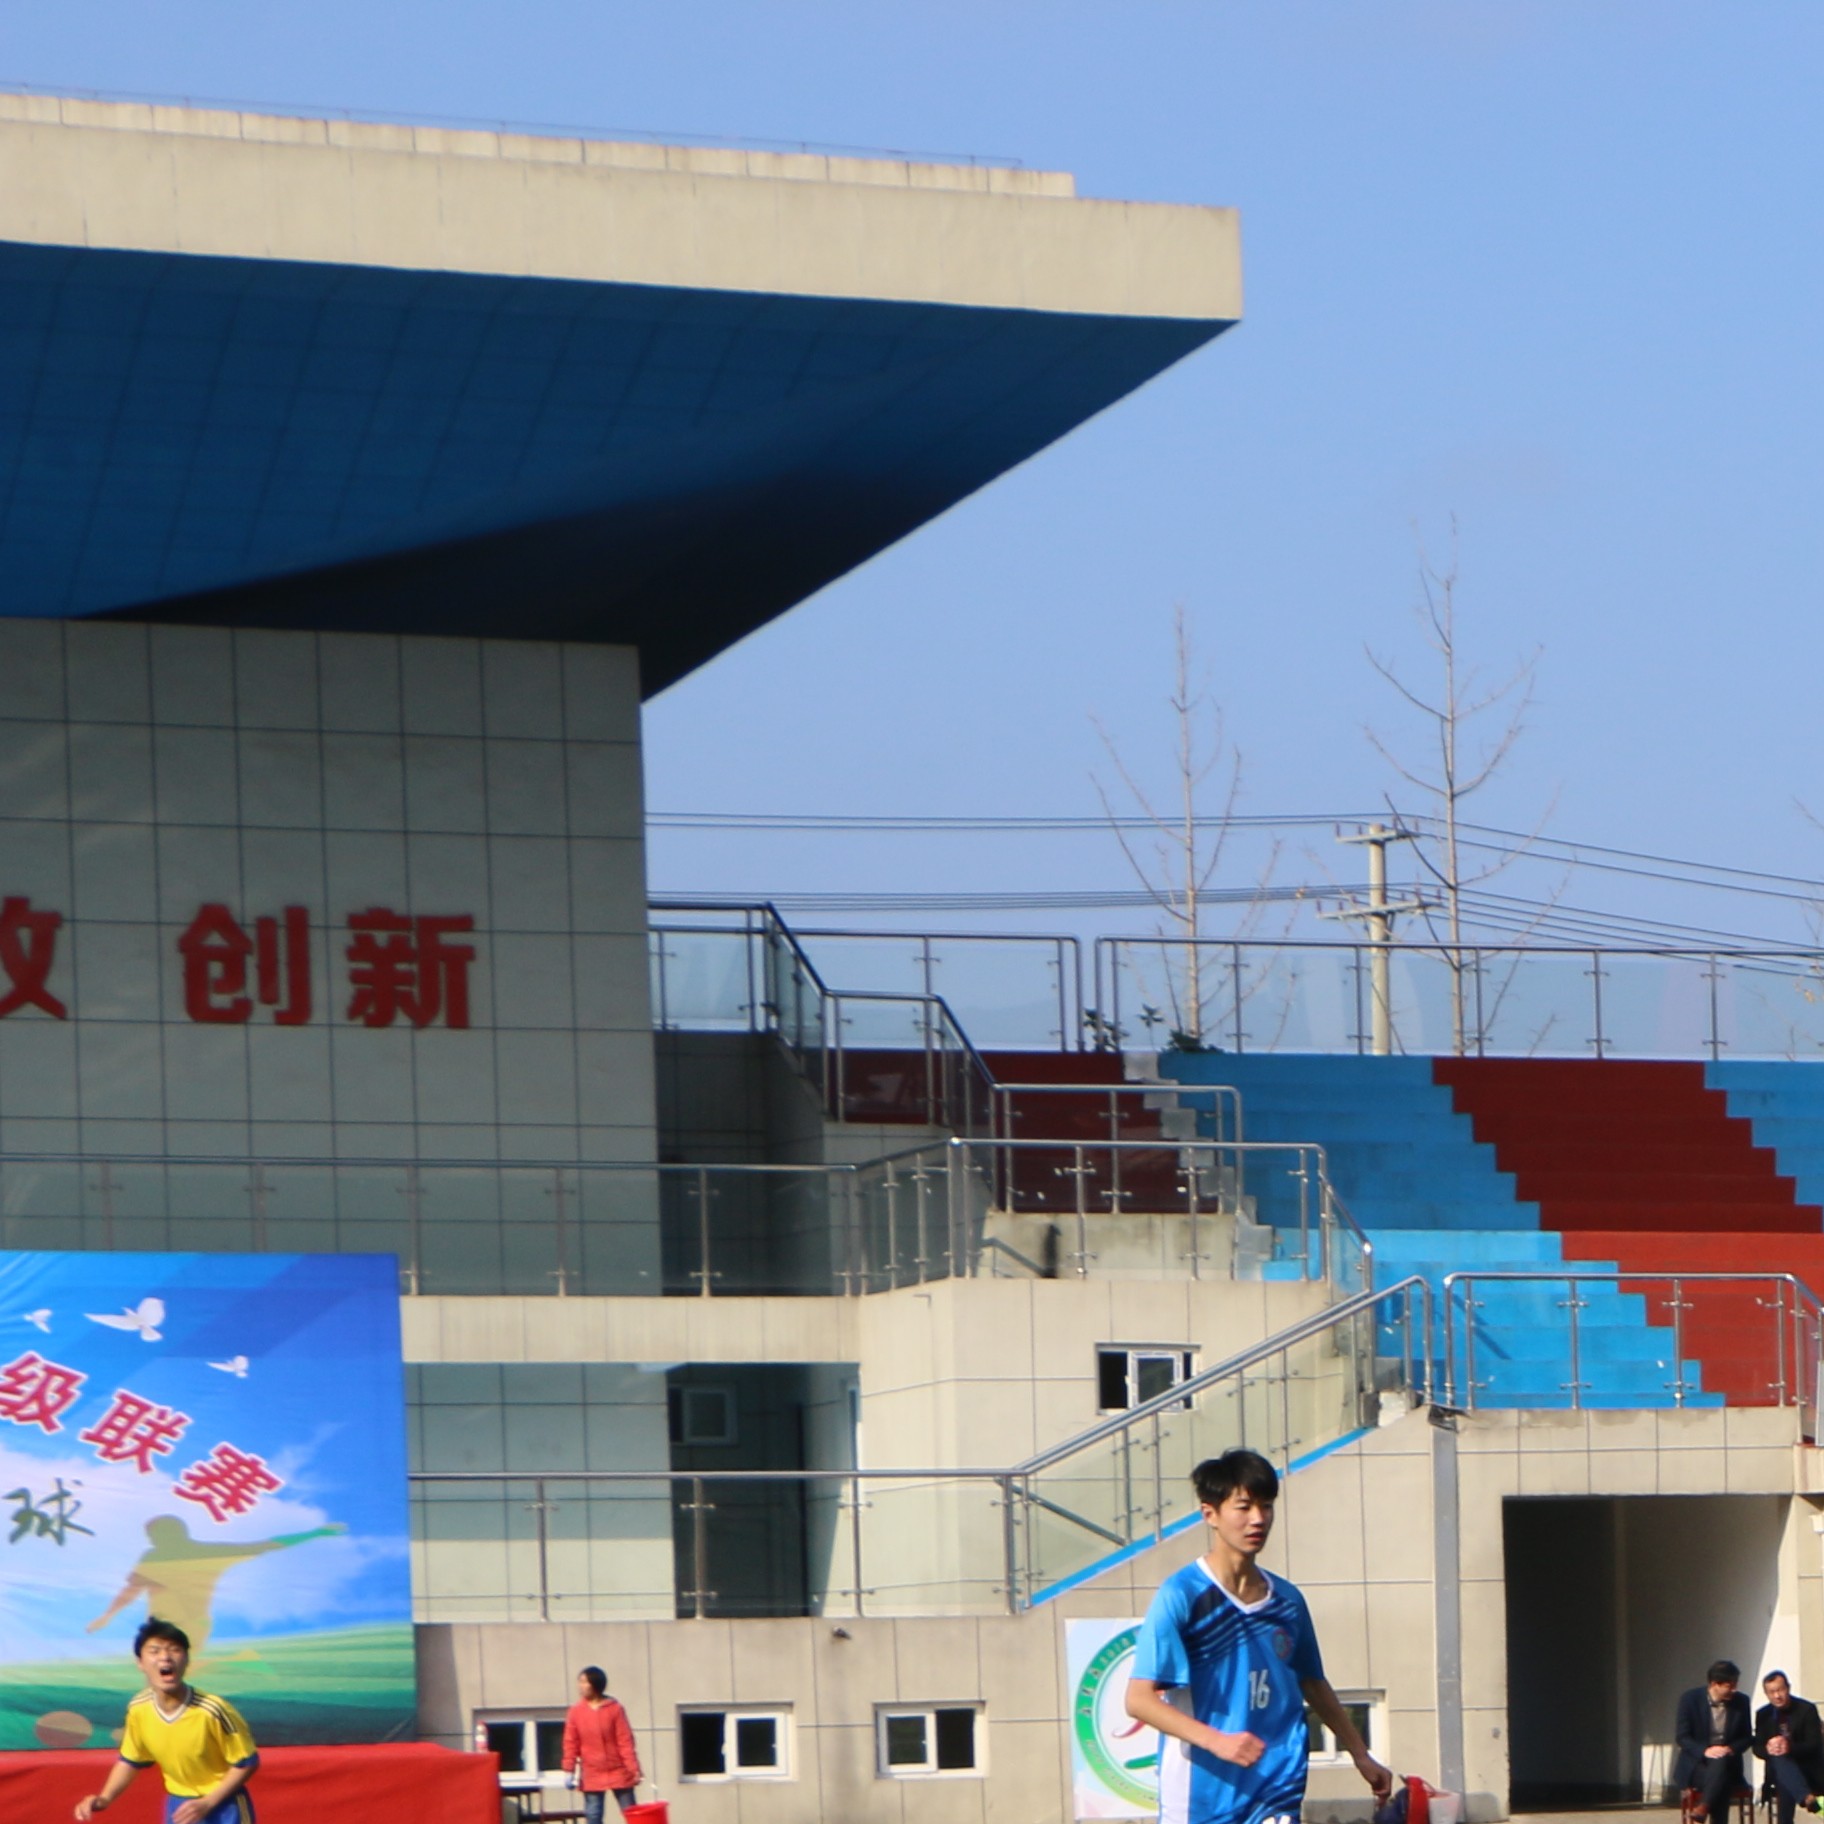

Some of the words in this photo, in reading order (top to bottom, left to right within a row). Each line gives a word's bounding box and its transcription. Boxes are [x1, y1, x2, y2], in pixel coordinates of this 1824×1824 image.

[178, 903, 476, 1029] 创新
[0, 1350, 285, 1524] 级联赛
[1248, 1668, 1271, 1712] 16
